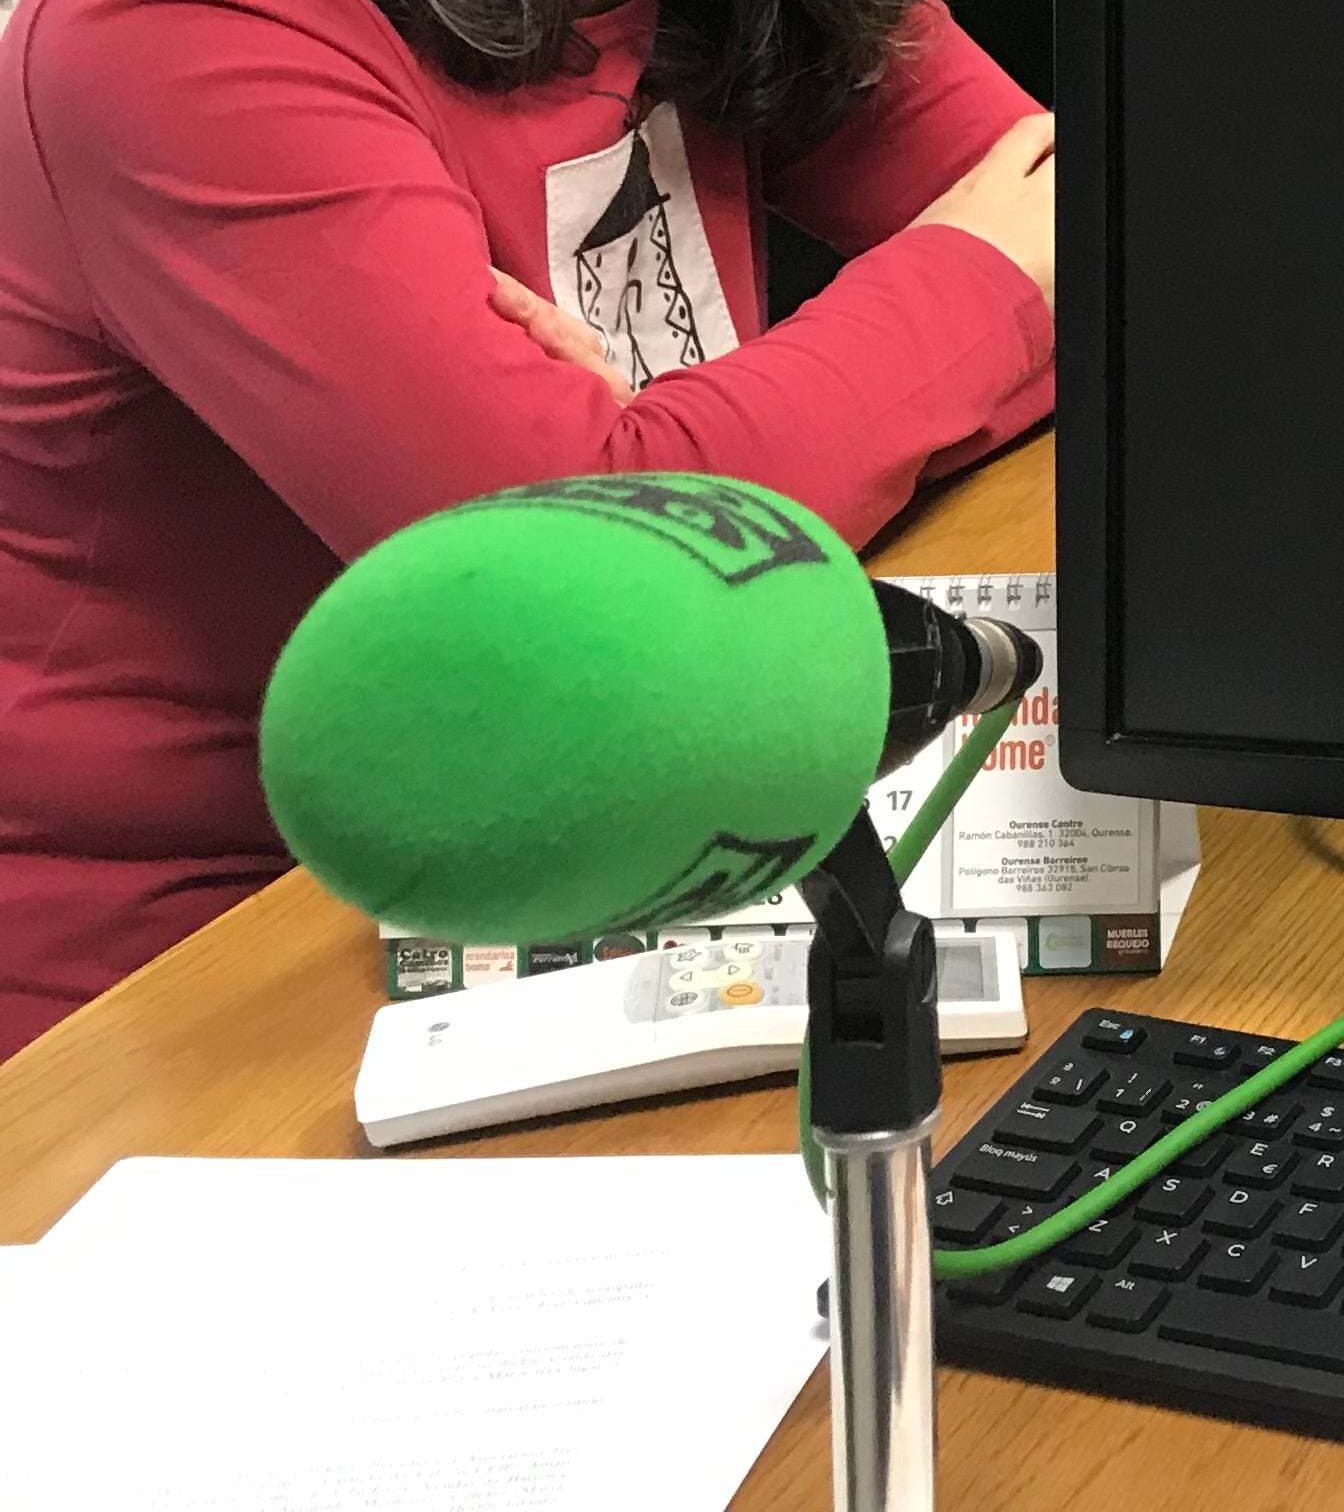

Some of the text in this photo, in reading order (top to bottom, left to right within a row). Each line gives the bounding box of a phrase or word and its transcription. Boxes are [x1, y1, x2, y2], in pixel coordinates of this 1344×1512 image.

[886, 790, 913, 812] 17
[1009, 820, 1050, 829] Ourense
[1017, 839, 1075, 848] 988 210 364
[1001, 857, 1041, 866] Ourense
[1080, 865, 1099, 874] San
[998, 875, 1015, 884] das
[1119, 1119, 1137, 1134] Q
[1307, 1121, 1321, 1133] 4
[978, 1142, 1004, 1157] Bloq
[1250, 1142, 1268, 1157] E
[1317, 1154, 1335, 1168] R
[1094, 1166, 1111, 1181] A
[1163, 1178, 1181, 1193] S
[1229, 1190, 1249, 1204] D
[1299, 1202, 1318, 1216] F
[1088, 1219, 1109, 1233] Z
[1155, 1230, 1178, 1245] X
[1227, 1243, 1246, 1258] C
[1300, 1255, 1318, 1270] V
[1114, 1278, 1135, 1291] Alt
